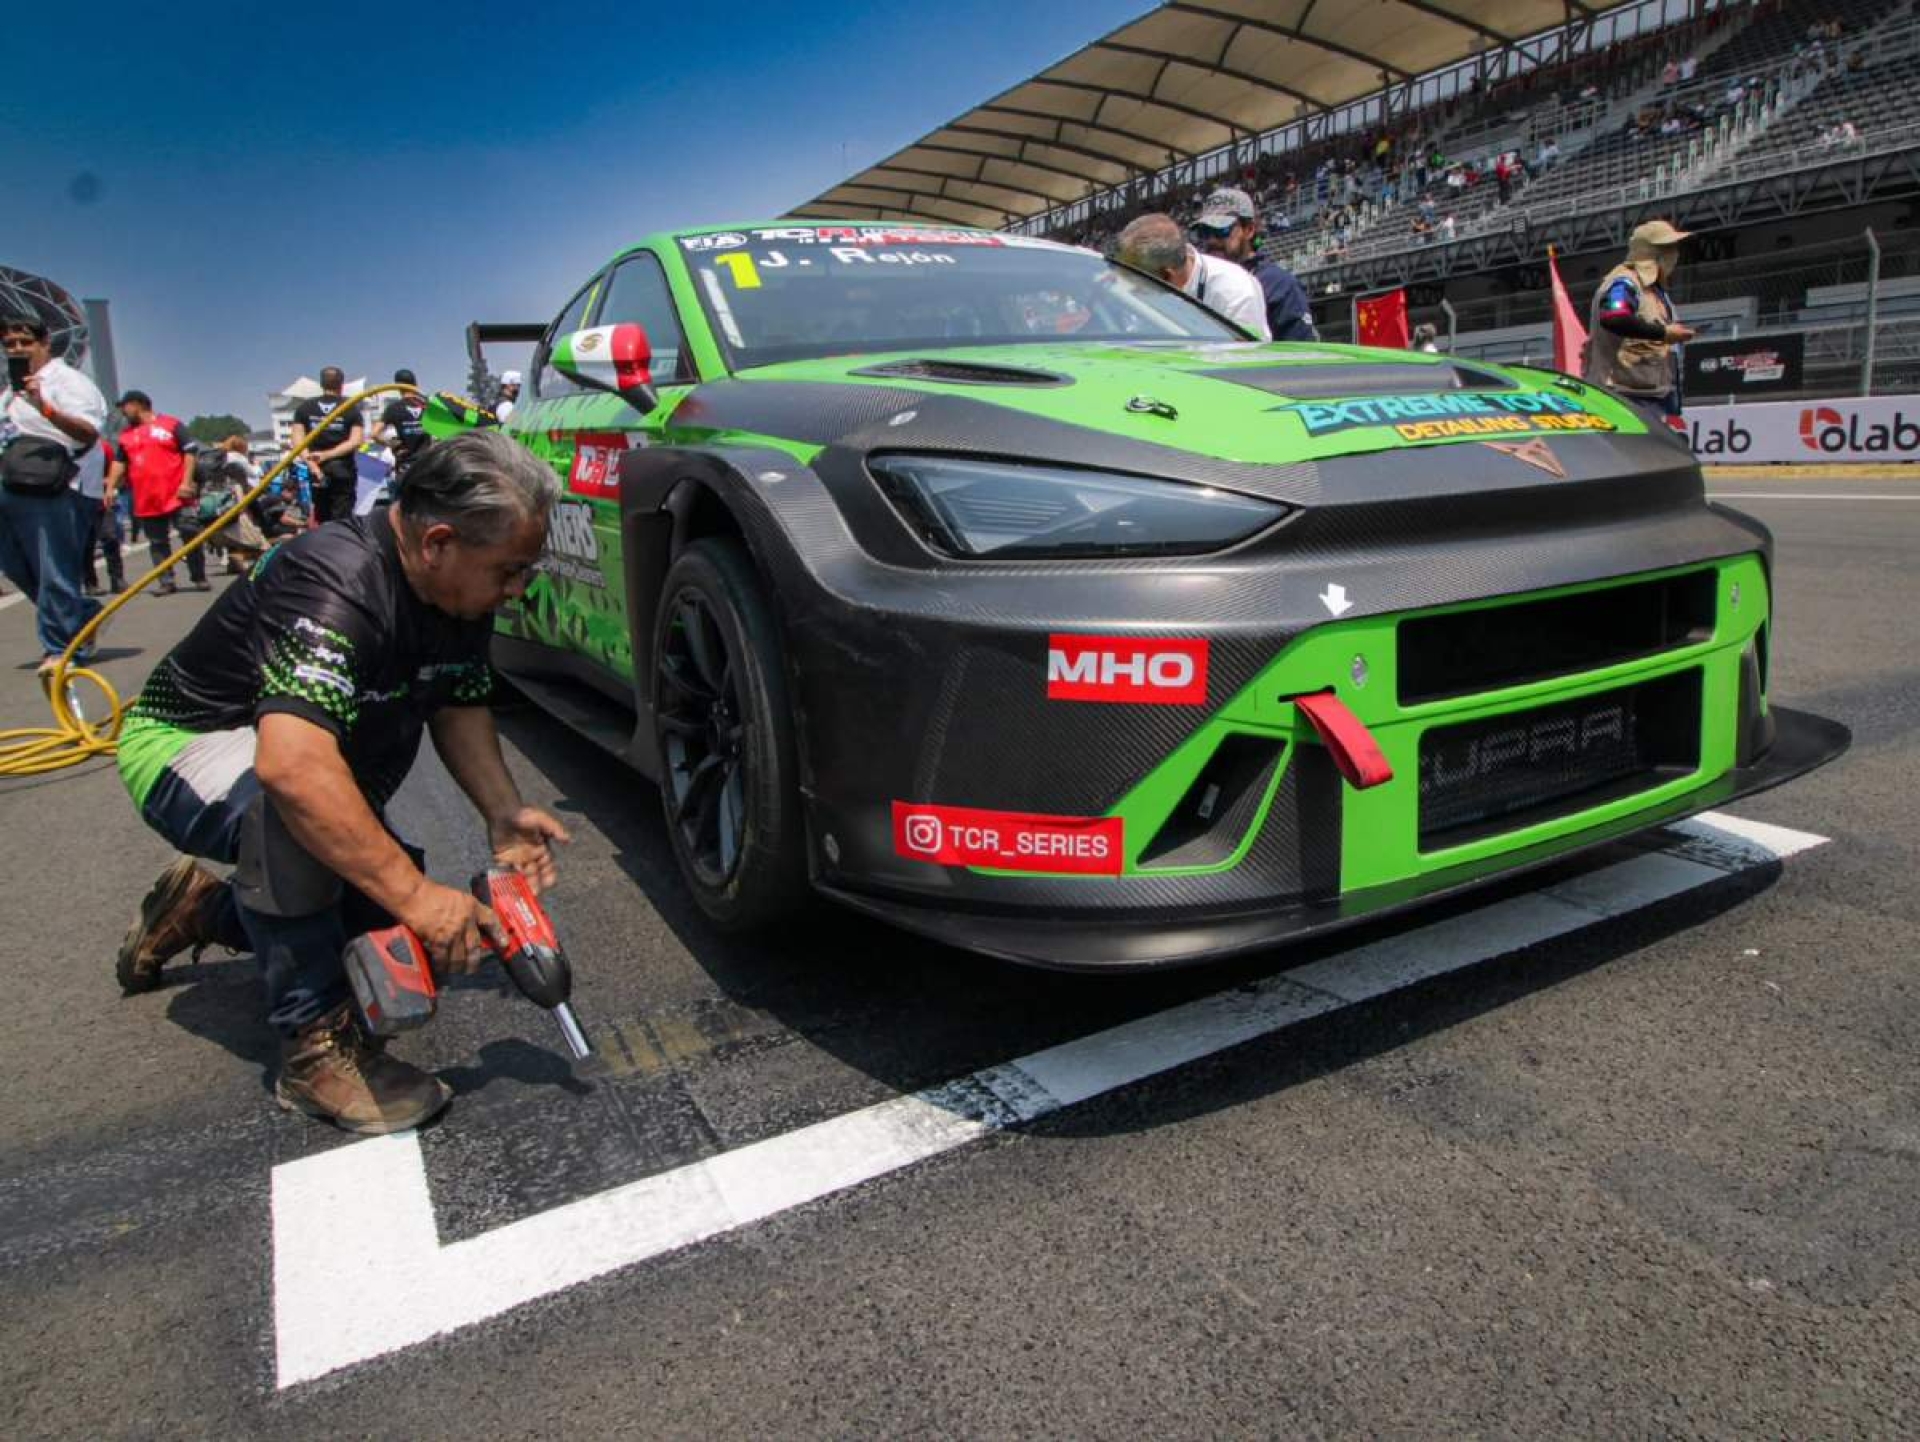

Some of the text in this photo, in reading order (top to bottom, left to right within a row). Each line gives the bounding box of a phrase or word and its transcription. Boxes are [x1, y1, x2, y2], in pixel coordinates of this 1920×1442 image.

[715, 252, 762, 289] 1
[1299, 390, 1585, 430] EXTREME TOYS
[1397, 415, 1530, 441] DETAILING
[1048, 650, 1194, 687] MHO
[948, 826, 1109, 859] TCR_SERIES
